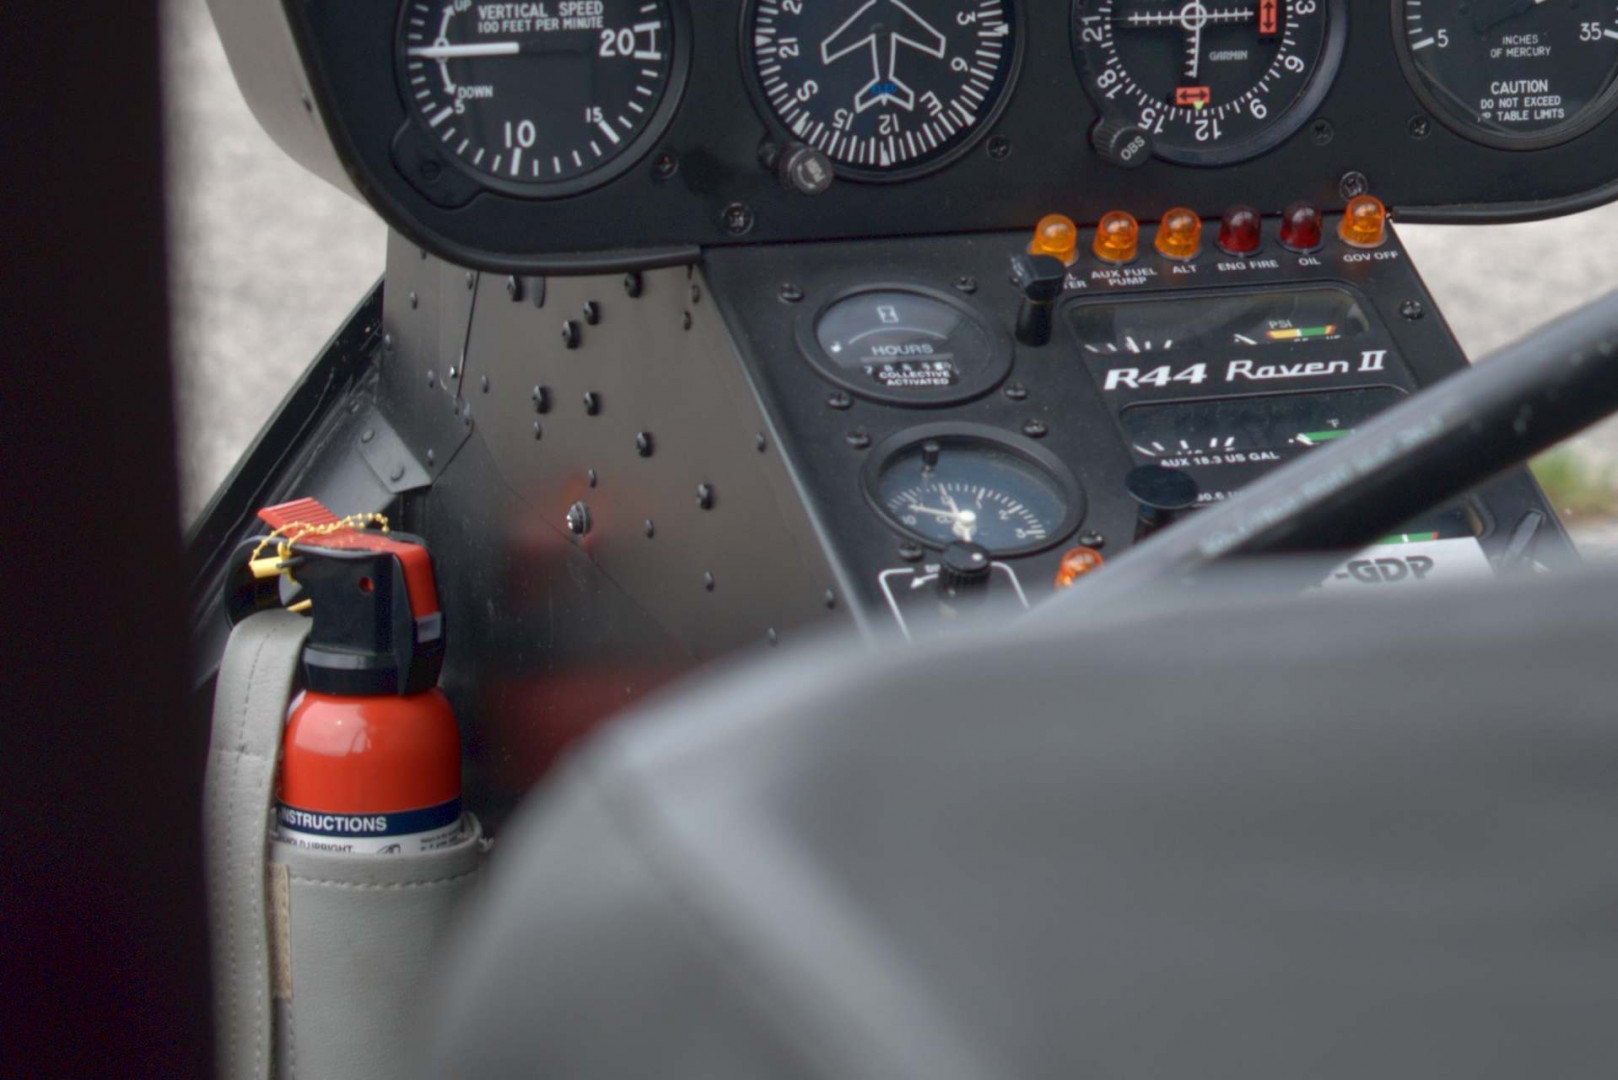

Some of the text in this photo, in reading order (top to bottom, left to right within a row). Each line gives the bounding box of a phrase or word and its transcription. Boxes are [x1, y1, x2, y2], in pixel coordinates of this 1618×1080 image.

[455, 0, 472, 12] UP
[477, 0, 604, 21] VERTICAL SPEED
[477, 15, 605, 34] 100 FEET PER MINUTE
[956, 10, 977, 26] 3
[1081, 14, 1103, 44] 21
[1579, 21, 1603, 43] 35
[599, 27, 637, 58] 20
[1436, 28, 1450, 49] 5
[1501, 33, 1540, 46] INCHES
[776, 36, 800, 59] 21
[1208, 50, 1249, 62] GARMIN
[1489, 45, 1552, 60] OF MERCURY
[1283, 54, 1306, 74] 6
[458, 85, 494, 99] DOWN
[795, 78, 819, 103] S
[1096, 69, 1124, 100] 18
[1490, 78, 1549, 96] CAUTION
[454, 98, 465, 114] 5
[919, 89, 945, 118] E
[1480, 94, 1562, 110] DO NOT EXCEED
[586, 106, 603, 124] 15
[832, 108, 855, 132] 15
[1138, 105, 1165, 135] 15
[1496, 109, 1530, 122] TABLE
[1533, 107, 1565, 120] LIMITS
[877, 113, 900, 135] 12
[1194, 119, 1224, 142] 12
[504, 119, 537, 149] 10
[1119, 133, 1147, 162] OBS
[1298, 256, 1322, 266] OIL
[1343, 250, 1400, 263] GOV OFF
[1091, 267, 1158, 280] AUX FUEL
[1172, 264, 1198, 275] ALT
[1217, 259, 1280, 272] ENG FIRE
[1108, 276, 1148, 286] PUMP
[1268, 320, 1293, 329] PSI
[871, 343, 934, 356] HOURS
[879, 370, 951, 379] COLLECTIVE
[886, 377, 950, 387] ACTIVATED
[1102, 361, 1208, 391] R44
[1224, 357, 1350, 383] Raven
[1160, 458, 1190, 468] AUX
[1225, 453, 1247, 463] US
[1248, 451, 1281, 461] GAL
